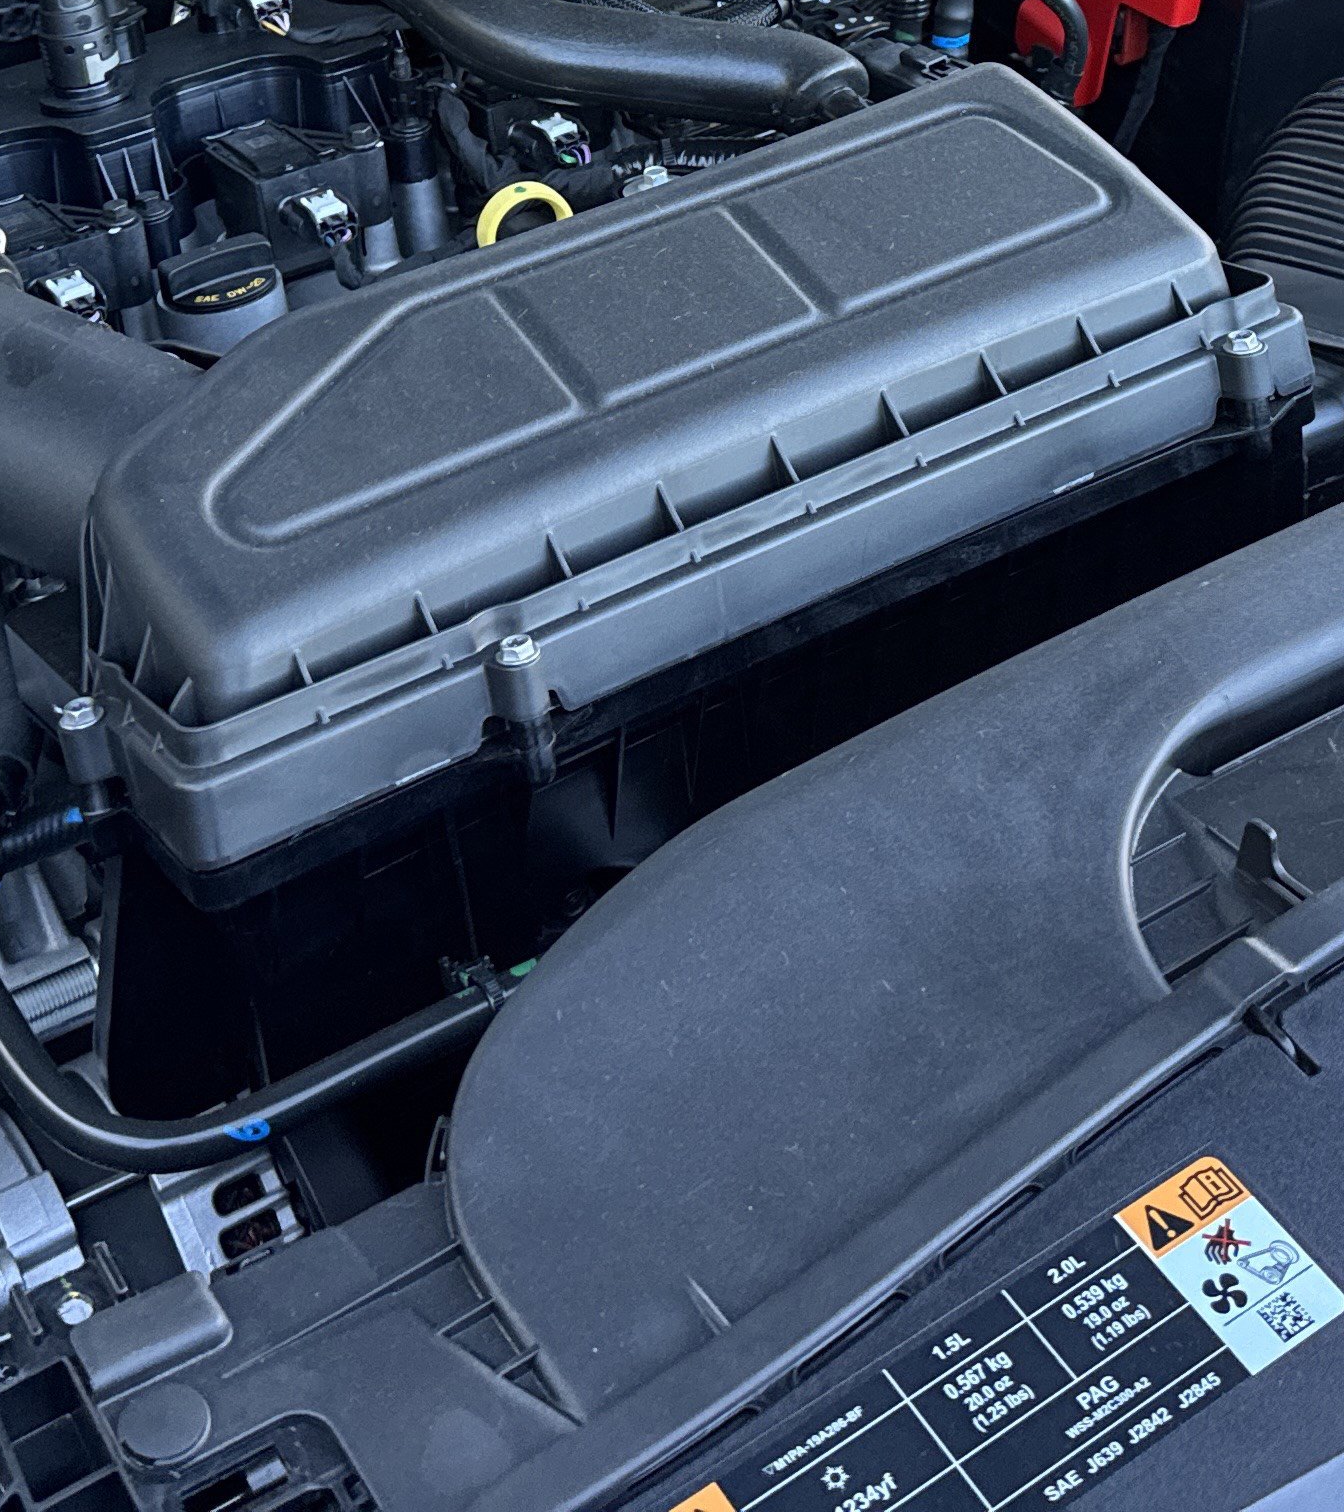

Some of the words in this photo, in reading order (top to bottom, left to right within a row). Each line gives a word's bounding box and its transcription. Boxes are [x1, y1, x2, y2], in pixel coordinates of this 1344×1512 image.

[1047, 1256, 1087, 1284] 2.0L
[1061, 1285, 1105, 1319] 0.539
[1100, 1273, 1129, 1293] kg
[1083, 1306, 1112, 1329] 19.0
[1111, 1296, 1130, 1312] oz
[932, 1333, 971, 1359] 1.5L
[1090, 1321, 1125, 1351] (1.19
[1120, 1304, 1151, 1328] lbs)
[943, 1363, 986, 1399] 0.567
[983, 1351, 1013, 1372] kg
[963, 1385, 995, 1411] 20.0
[993, 1375, 1014, 1391] oz
[1076, 1376, 1120, 1410] PAG
[972, 1401, 1008, 1433] (1.25
[1003, 1384, 1035, 1409] lbs)
[1044, 1470, 1083, 1501] SAE
[1087, 1441, 1124, 1473] J639
[1127, 1407, 1173, 1444] J2842
[1178, 1372, 1221, 1409] J2845
[834, 1473, 897, 1512] 234yf
